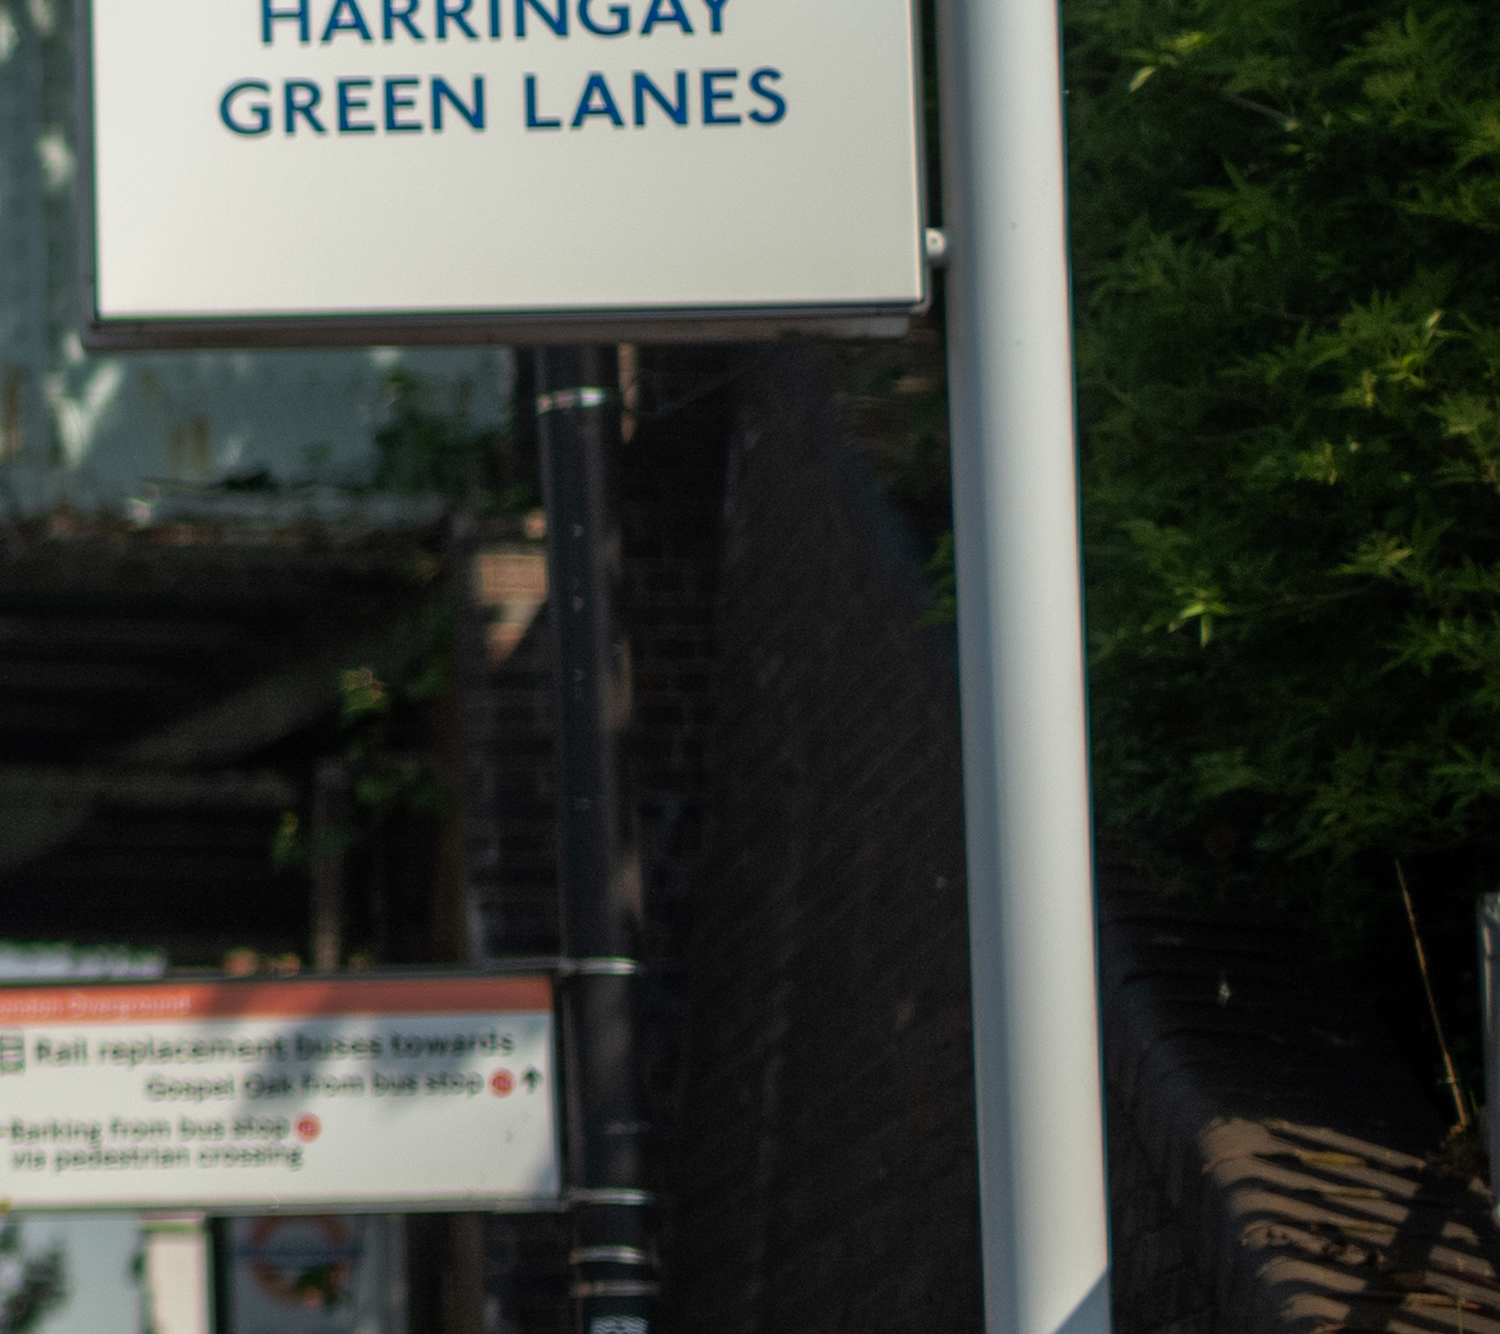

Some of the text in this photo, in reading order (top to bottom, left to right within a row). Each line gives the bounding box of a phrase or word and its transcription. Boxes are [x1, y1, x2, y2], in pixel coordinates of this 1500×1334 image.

[218, 67, 788, 137] GREEN LANES
[68, 991, 192, 1021] Overground
[36, 1029, 514, 1069] Rail replacement buses towards
[147, 1074, 235, 1101] Gospel
[244, 1073, 293, 1098] Oak
[302, 1071, 365, 1096] from
[372, 1071, 418, 1096] bus
[425, 1070, 485, 1097] stop
[10, 1118, 102, 1148] Barking
[111, 1116, 171, 1140] from
[179, 1115, 225, 1140] bus
[233, 1114, 290, 1140] stop
[12, 1145, 303, 1174] via pedestrian crossing
